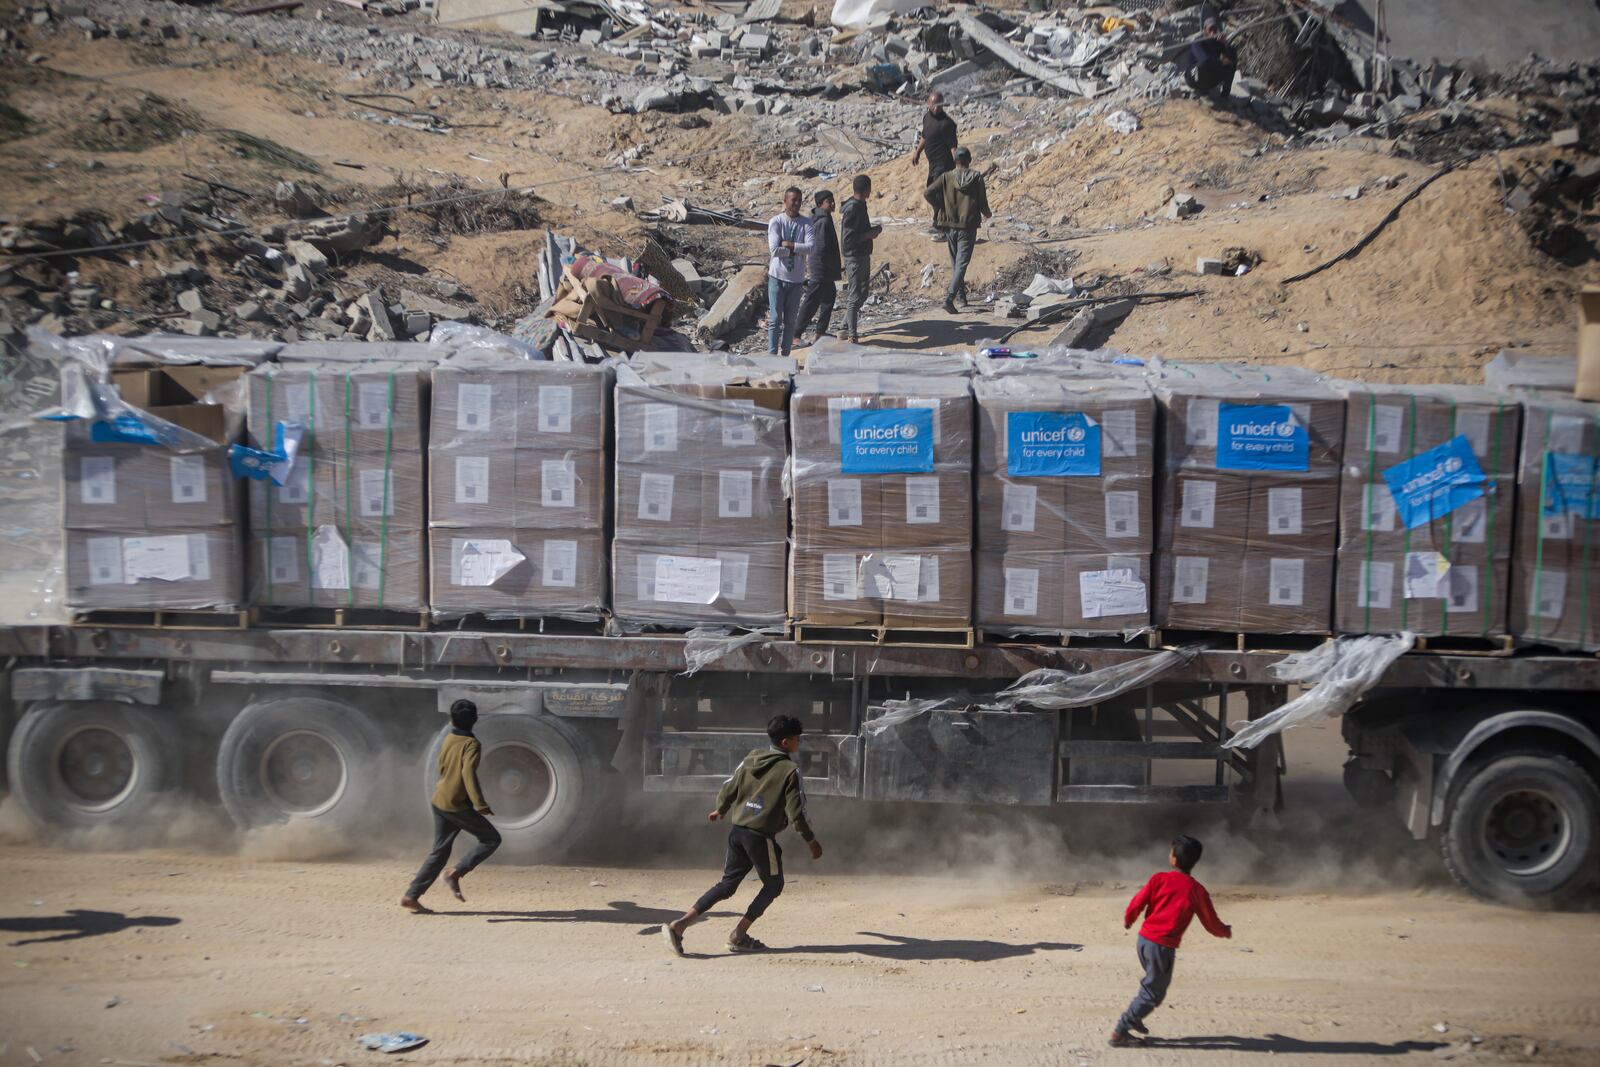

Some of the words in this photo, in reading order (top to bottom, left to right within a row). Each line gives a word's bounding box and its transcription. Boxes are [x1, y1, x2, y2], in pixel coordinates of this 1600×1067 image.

[854, 424, 900, 440] unicef
[1021, 427, 1067, 442] unicef
[1231, 421, 1276, 437] unicef
[855, 445, 868, 455] for
[869, 446, 896, 457] every
[897, 445, 918, 455] child
[1023, 447, 1035, 457] for
[1036, 448, 1063, 459] every
[1064, 447, 1085, 457] child
[1231, 441, 1244, 450] for
[1245, 443, 1271, 453] every
[1272, 443, 1294, 452] child
[591, 692, 625, 703] شركة
